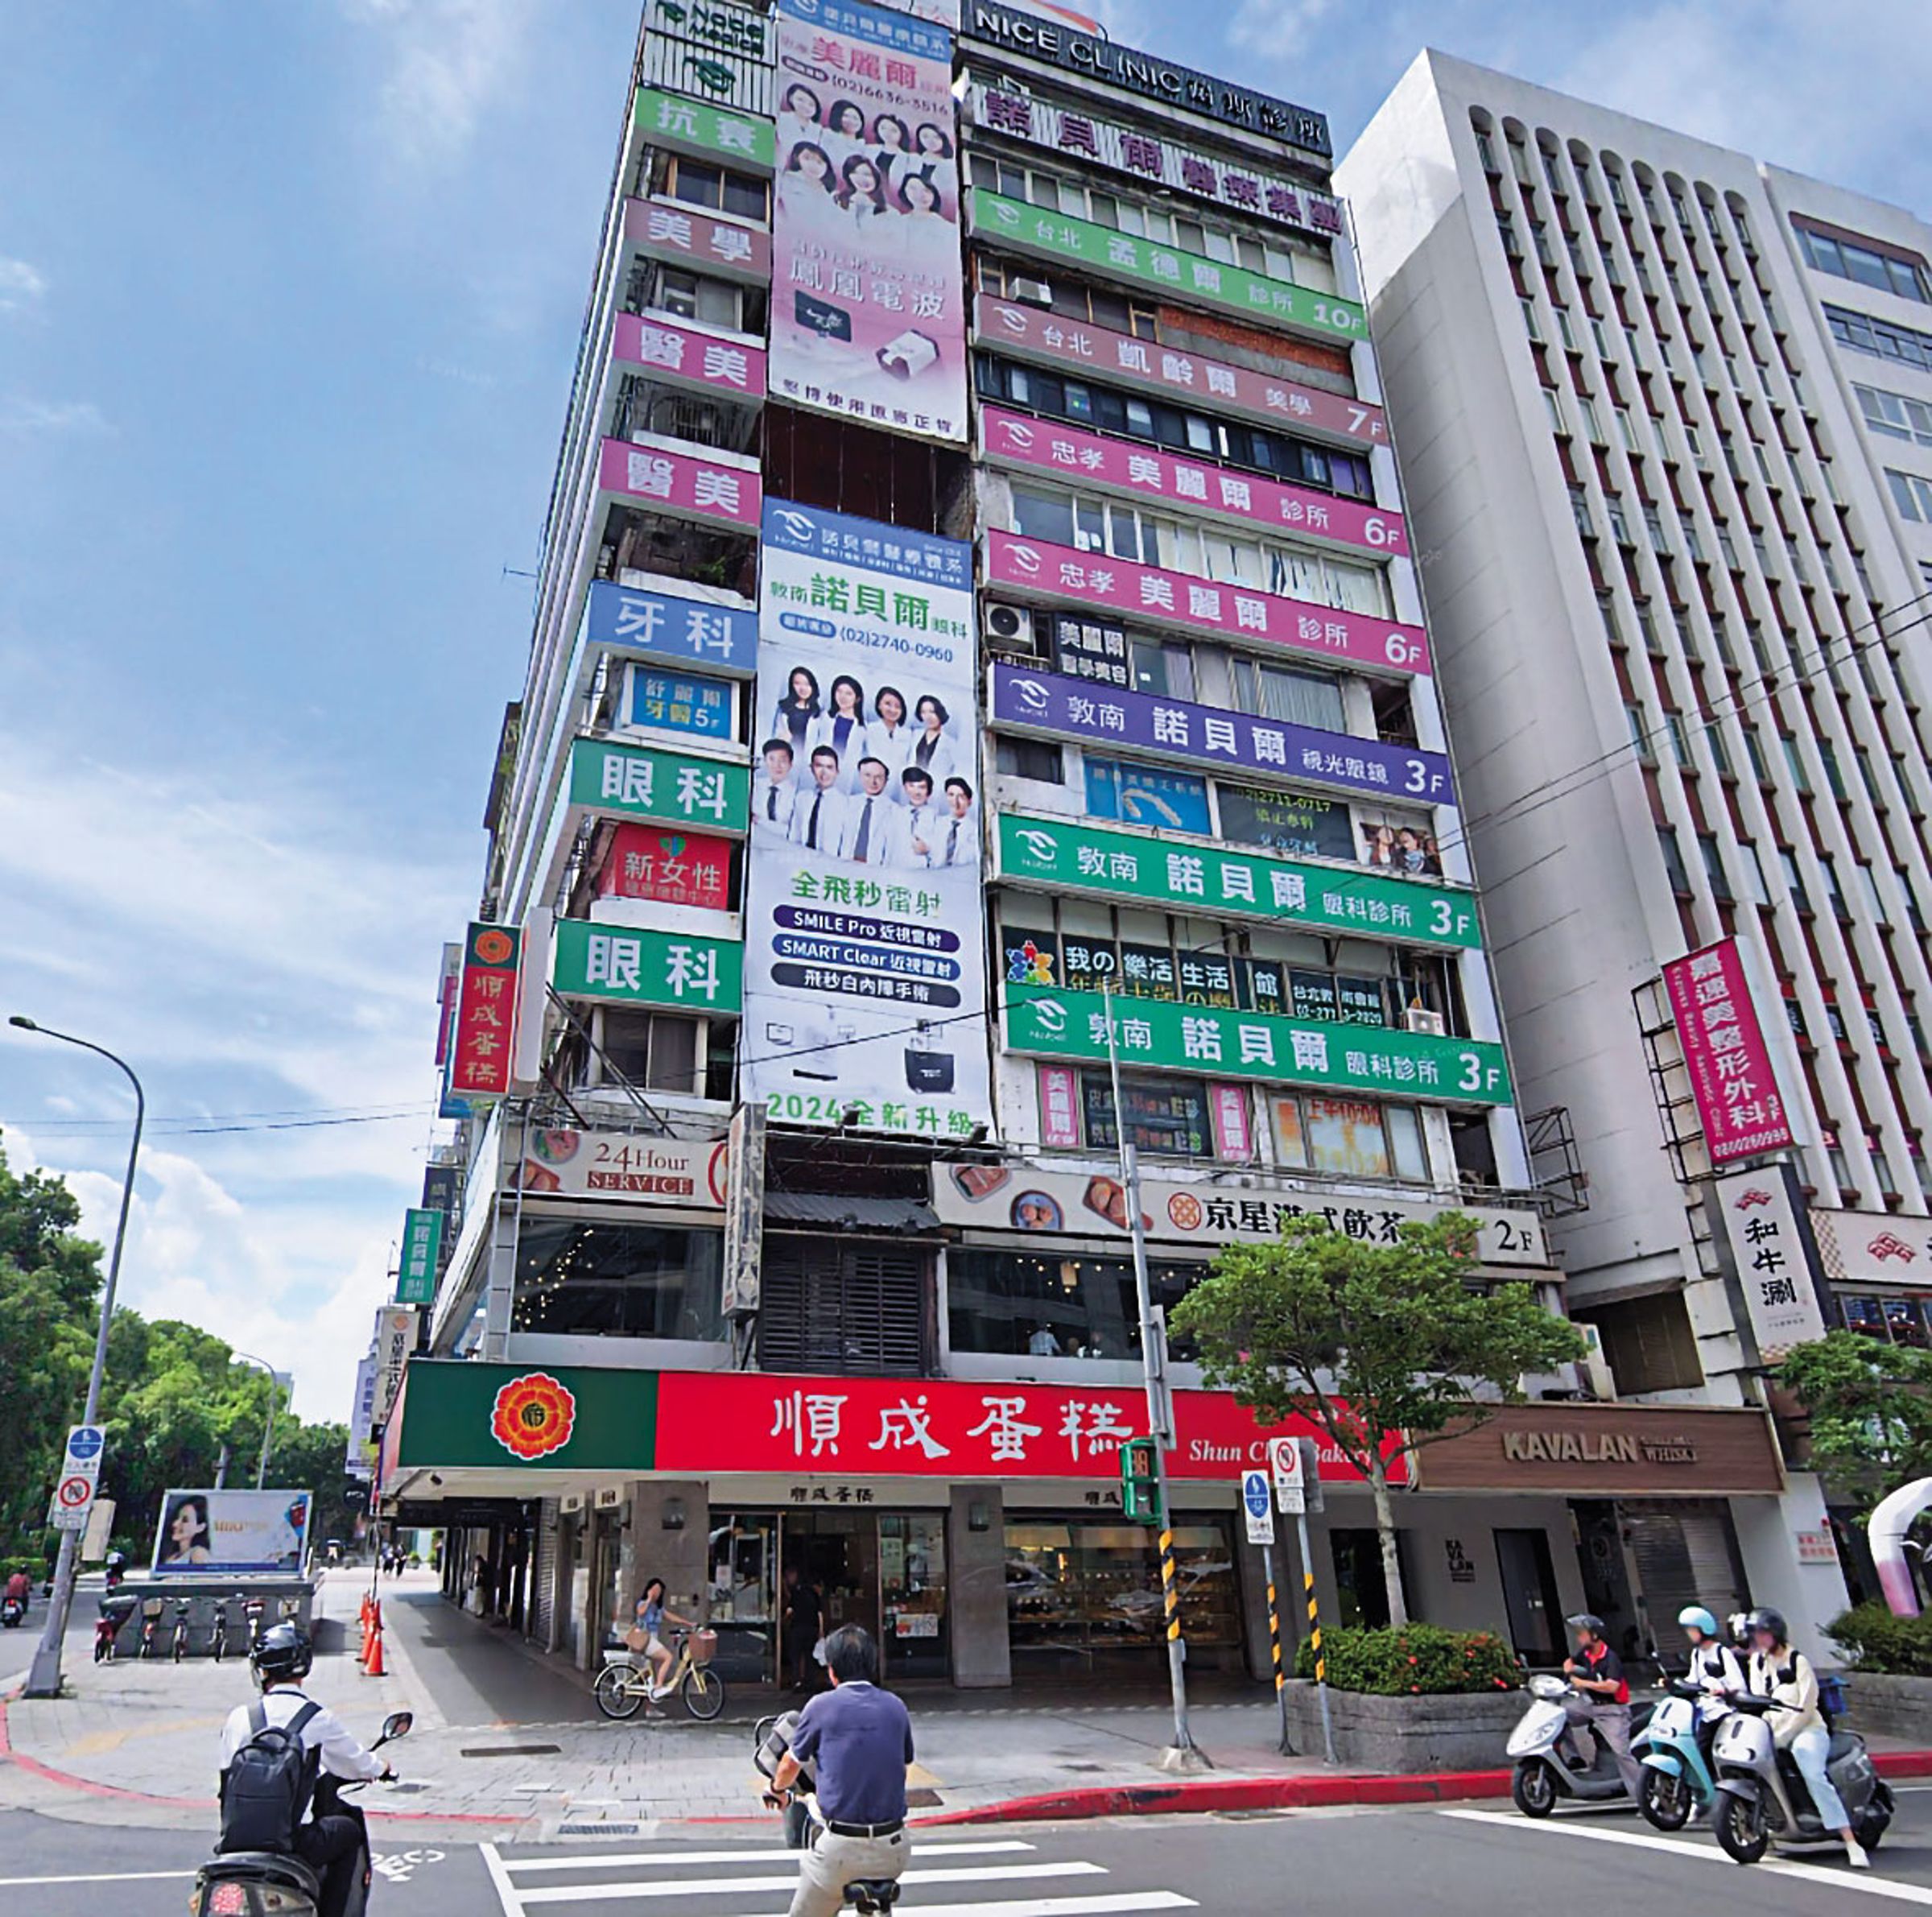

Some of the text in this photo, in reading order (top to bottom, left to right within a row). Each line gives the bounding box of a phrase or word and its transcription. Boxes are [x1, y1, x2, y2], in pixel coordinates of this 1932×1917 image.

[811, 37, 917, 89] 美麗爾
[976, 8, 1182, 93] NICE CLINIC
[658, 99, 757, 155] 抗衰
[648, 210, 752, 263] 美學
[791, 256, 945, 320] 鳳凰電波
[1035, 220, 1363, 332] 台北 孟德爾 診所 10F
[639, 325, 748, 387] 醫美
[1042, 324, 1383, 436] 台北 凱齡爾 美學 7F
[626, 450, 741, 514] 醫美
[1051, 440, 1400, 547] 忠孝 美麗爾 診所 6F
[613, 596, 733, 659] 牙科
[810, 572, 930, 631] 諾貝爾
[1059, 562, 1117, 594] 忠孝
[1139, 574, 1269, 632] 美麗爾
[1297, 615, 1350, 649] 診所
[1384, 634, 1422, 664] 6F
[840, 626, 954, 663] (02)2740-0960
[1067, 695, 1125, 732] 敦南
[1152, 705, 1288, 766] 諾貝爾
[1403, 759, 1445, 795] 3F
[602, 754, 729, 820] 眼科
[625, 850, 721, 892] 新女性
[791, 870, 942, 919] 全飛秒雷射
[1075, 845, 1471, 936] 敦南 諾貝爾 眼科診所 3F
[782, 939, 840, 961] SMART
[844, 948, 888, 968] Clear
[794, 911, 844, 933] SMILE
[848, 919, 877, 937] Pro
[585, 933, 720, 1000] 眼科
[804, 969, 931, 1003] 飛秒白內障手術
[464, 975, 507, 1085] 順成蛋糕
[1088, 1012, 1500, 1093] 敦南 諾貝爾 眼科診所 3F
[589, 1173, 692, 1196] SERVICE
[1494, 1218, 1532, 1254] 2F
[1744, 1217, 1798, 1307] 和牛涮
[770, 1390, 1135, 1462] 順成蛋糕
[1188, 1438, 1241, 1463] Shun
[1502, 1432, 1639, 1462] KAVALAN
[1644, 1446, 1699, 1463] WHISKY
